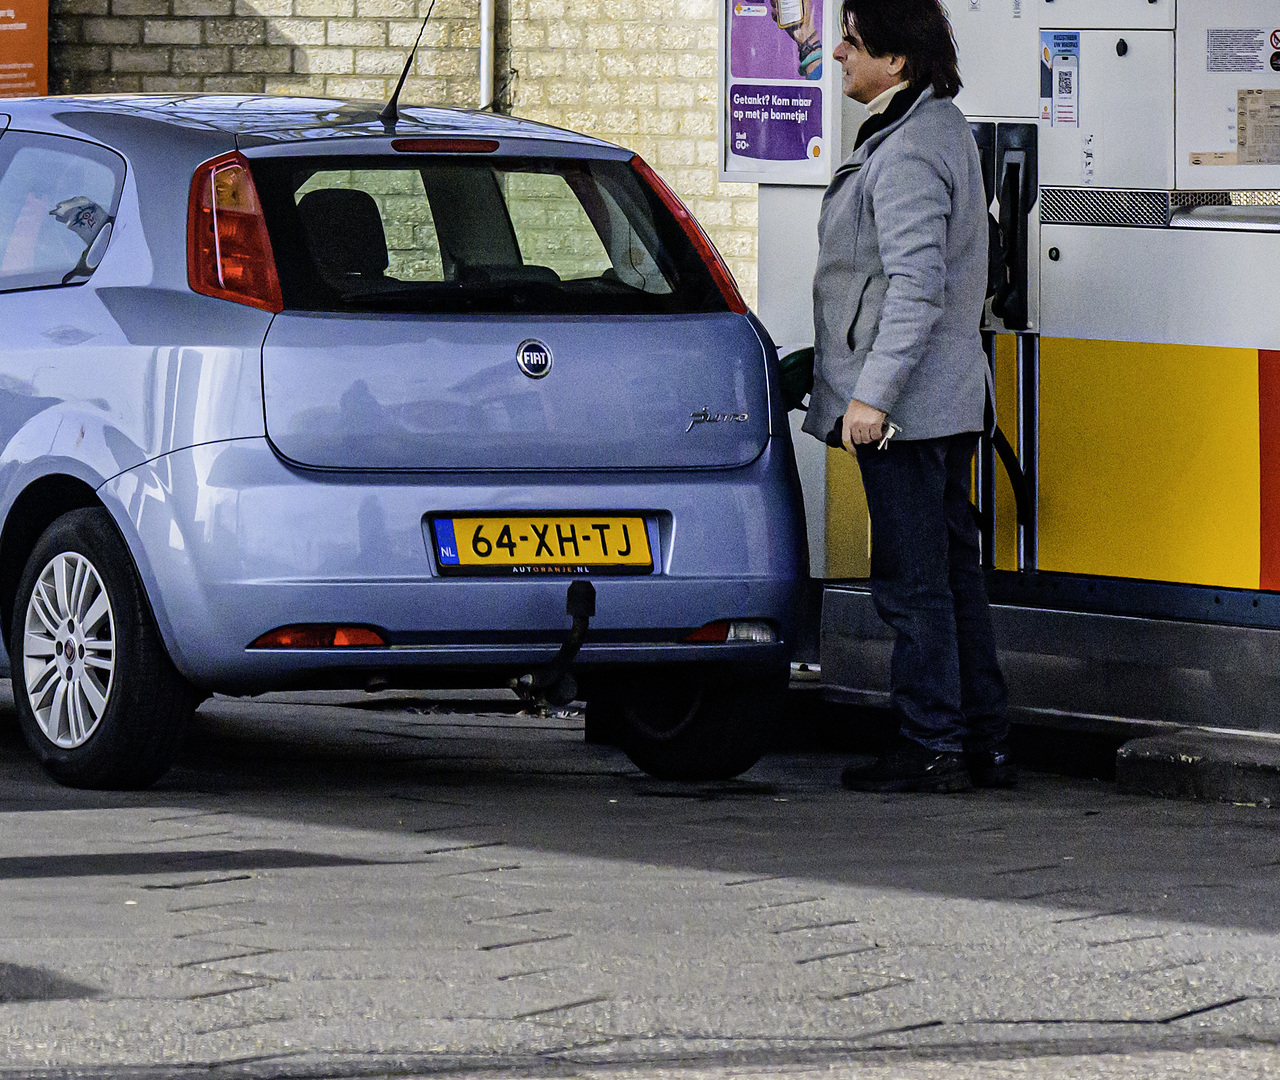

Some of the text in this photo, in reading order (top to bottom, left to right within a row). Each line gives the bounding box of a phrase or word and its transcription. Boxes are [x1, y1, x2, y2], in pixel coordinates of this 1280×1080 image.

[733, 93, 812, 107] Getankt? Kom maar
[733, 108, 808, 124] op met je bonnetje!
[735, 140, 750, 150] GO+
[523, 351, 547, 365] FIAT
[471, 523, 633, 558] 64-XH-TJ
[440, 546, 456, 558] NL
